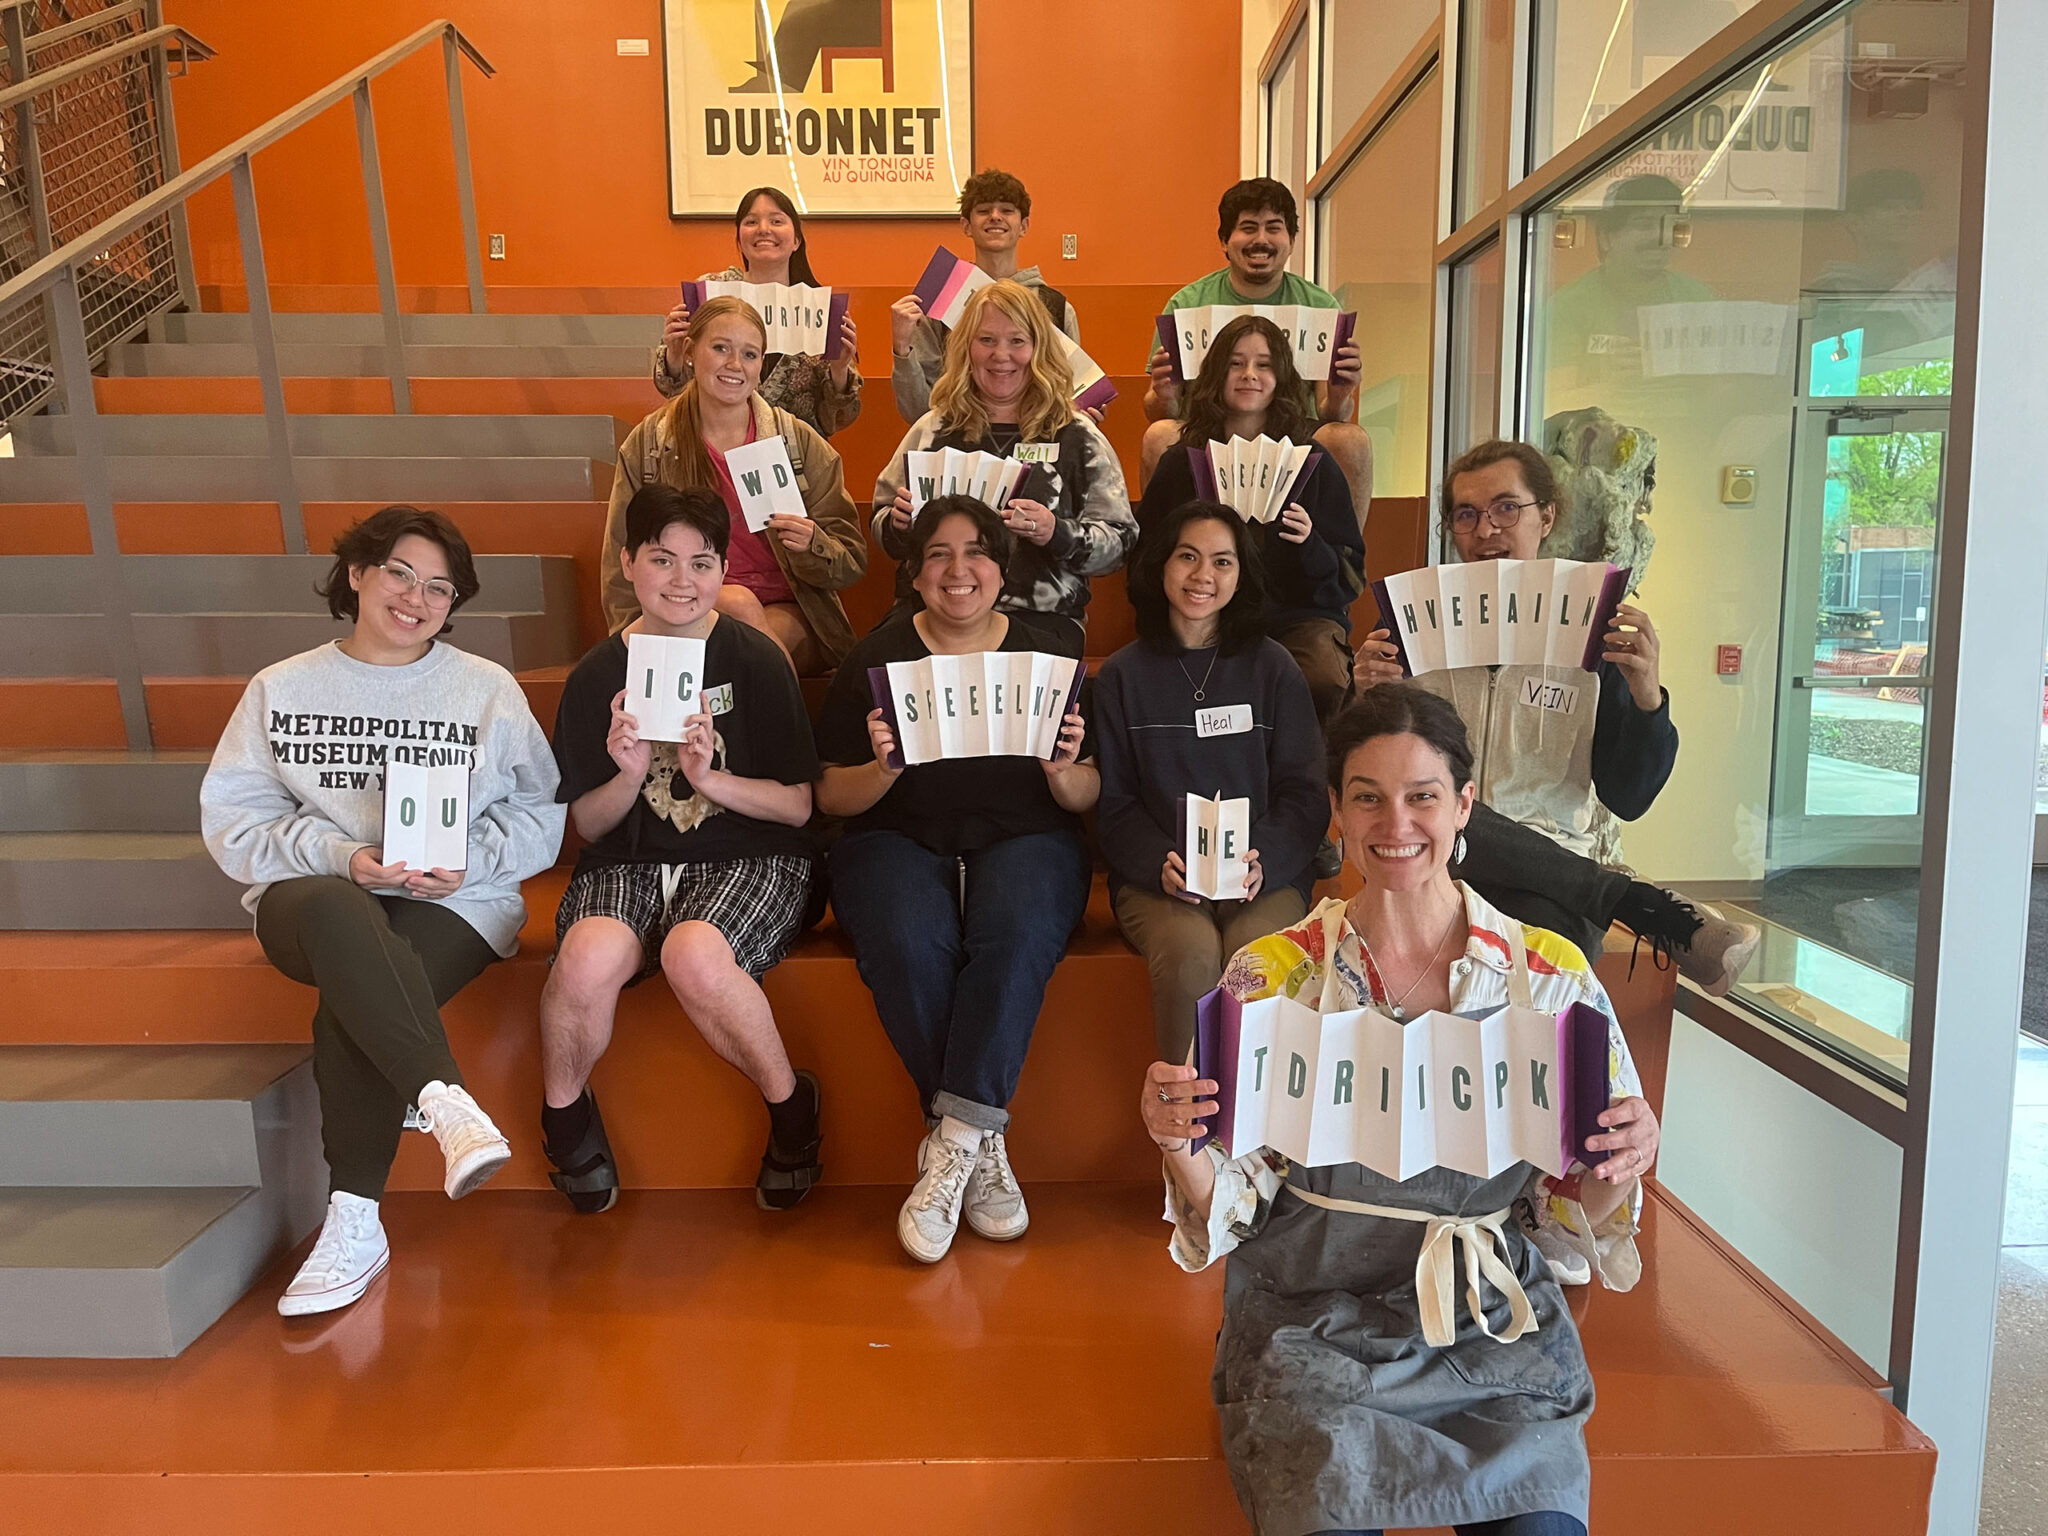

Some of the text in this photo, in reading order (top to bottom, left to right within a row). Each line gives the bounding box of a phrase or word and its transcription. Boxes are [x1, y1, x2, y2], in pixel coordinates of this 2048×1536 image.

[705, 108, 940, 155] DUBONNET
[822, 157, 935, 170] VIN TONIQUE
[822, 170, 935, 183] AU QUINQUINA
[1017, 446, 1049, 459] Wall
[1528, 680, 1573, 713] VEIN
[270, 710, 478, 746] METROPOLITAN
[1201, 714, 1233, 733] Heal
[270, 740, 388, 766] MUSEUM
[319, 771, 370, 790] NEW
[1254, 1046, 1550, 1113] TDRIICPK
